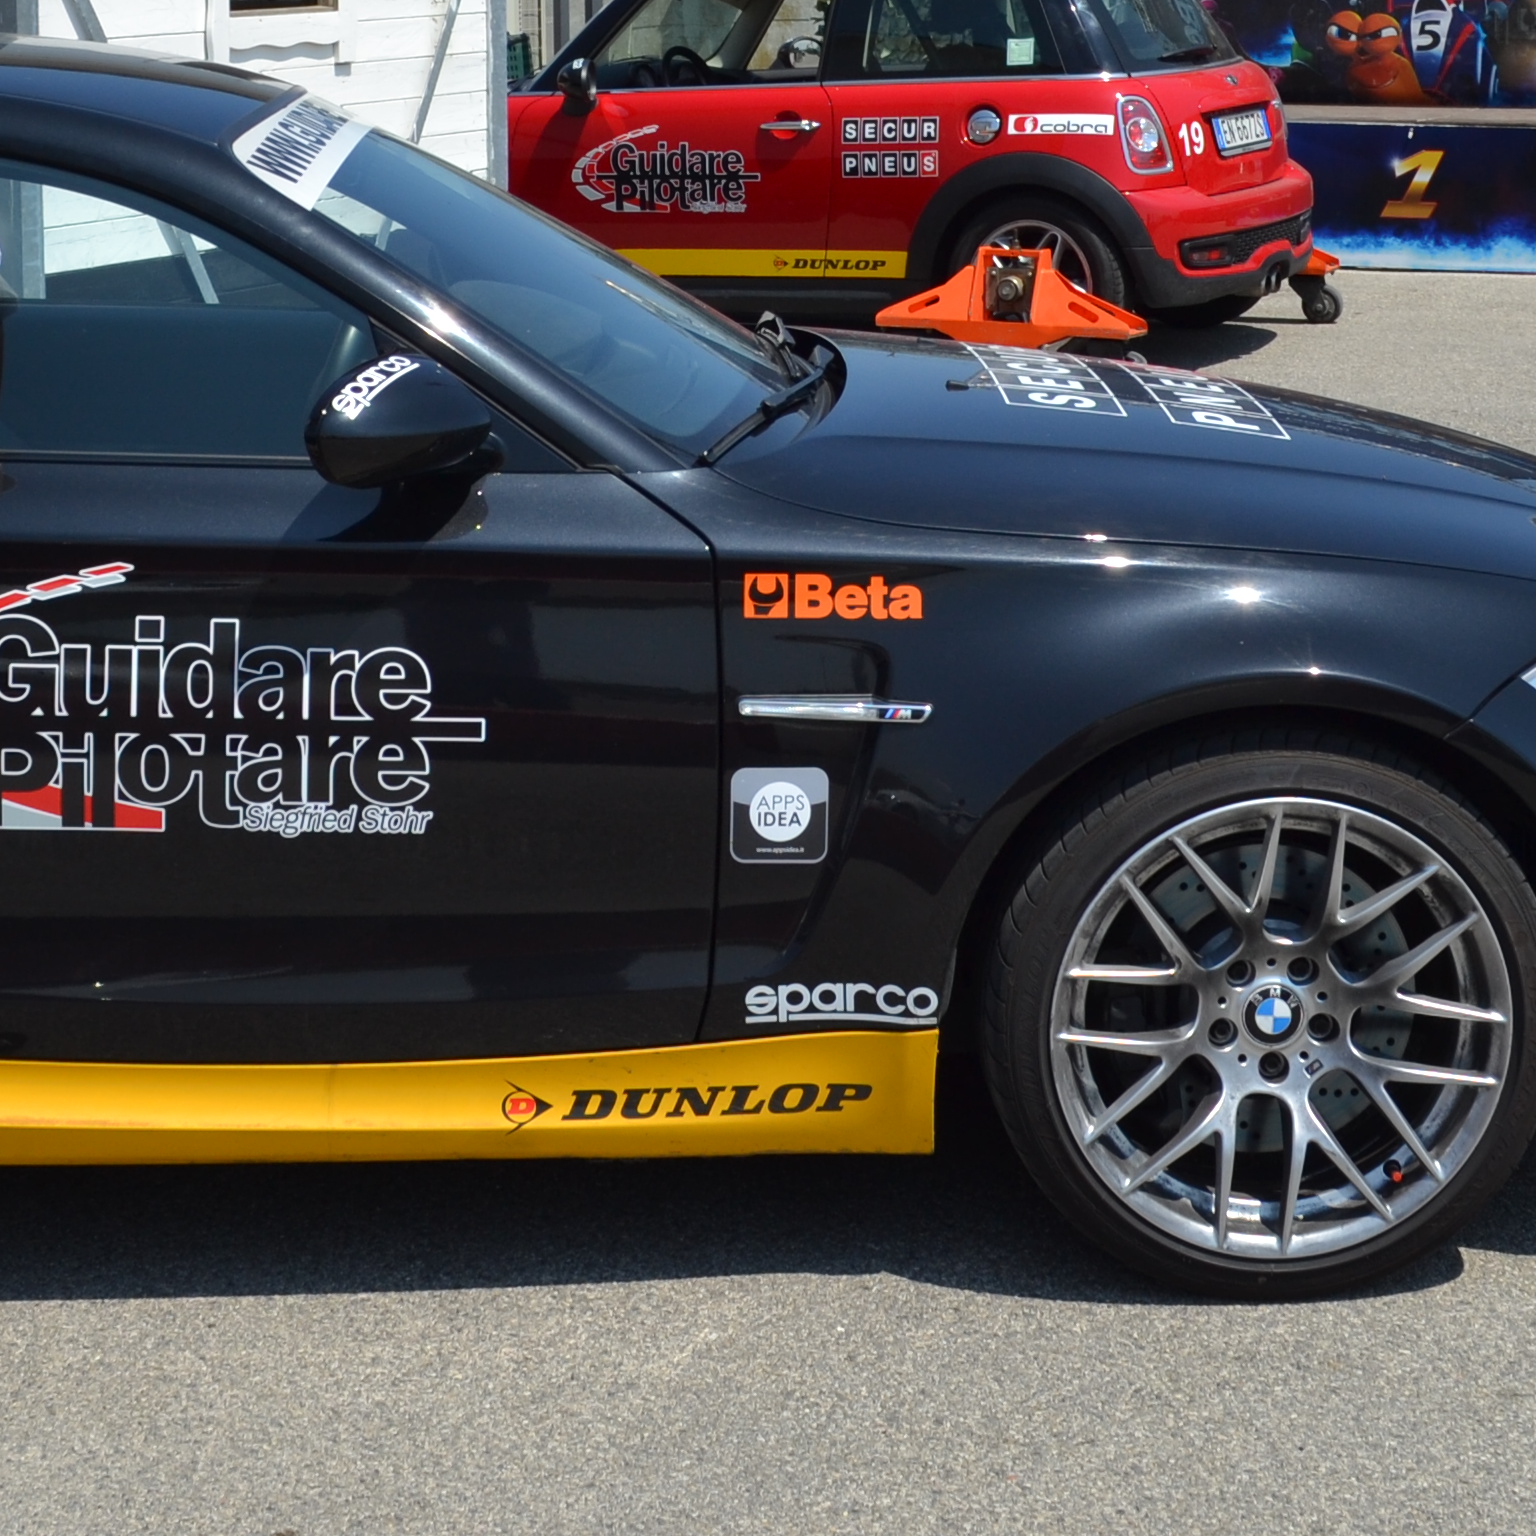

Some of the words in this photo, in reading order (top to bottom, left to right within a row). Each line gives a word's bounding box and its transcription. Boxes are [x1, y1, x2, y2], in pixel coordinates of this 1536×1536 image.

[1415, 18, 1441, 52] 5
[844, 120, 937, 141] SECUR
[1039, 119, 1108, 134] cobra
[1178, 120, 1205, 157] 19
[610, 141, 745, 176] Guidare
[844, 154, 937, 174] PNEUS
[614, 178, 745, 212] Pilotare
[1381, 149, 1444, 219] 1
[792, 257, 887, 272] DUNLOP
[332, 354, 420, 421] sparco
[794, 573, 924, 620] Beta
[756, 794, 805, 811] APPS
[757, 811, 802, 827] IDEA
[244, 804, 356, 838] Siegfried
[359, 805, 433, 835] Stohr
[745, 982, 938, 1024] sparco
[561, 1083, 874, 1121] DUNLOP
